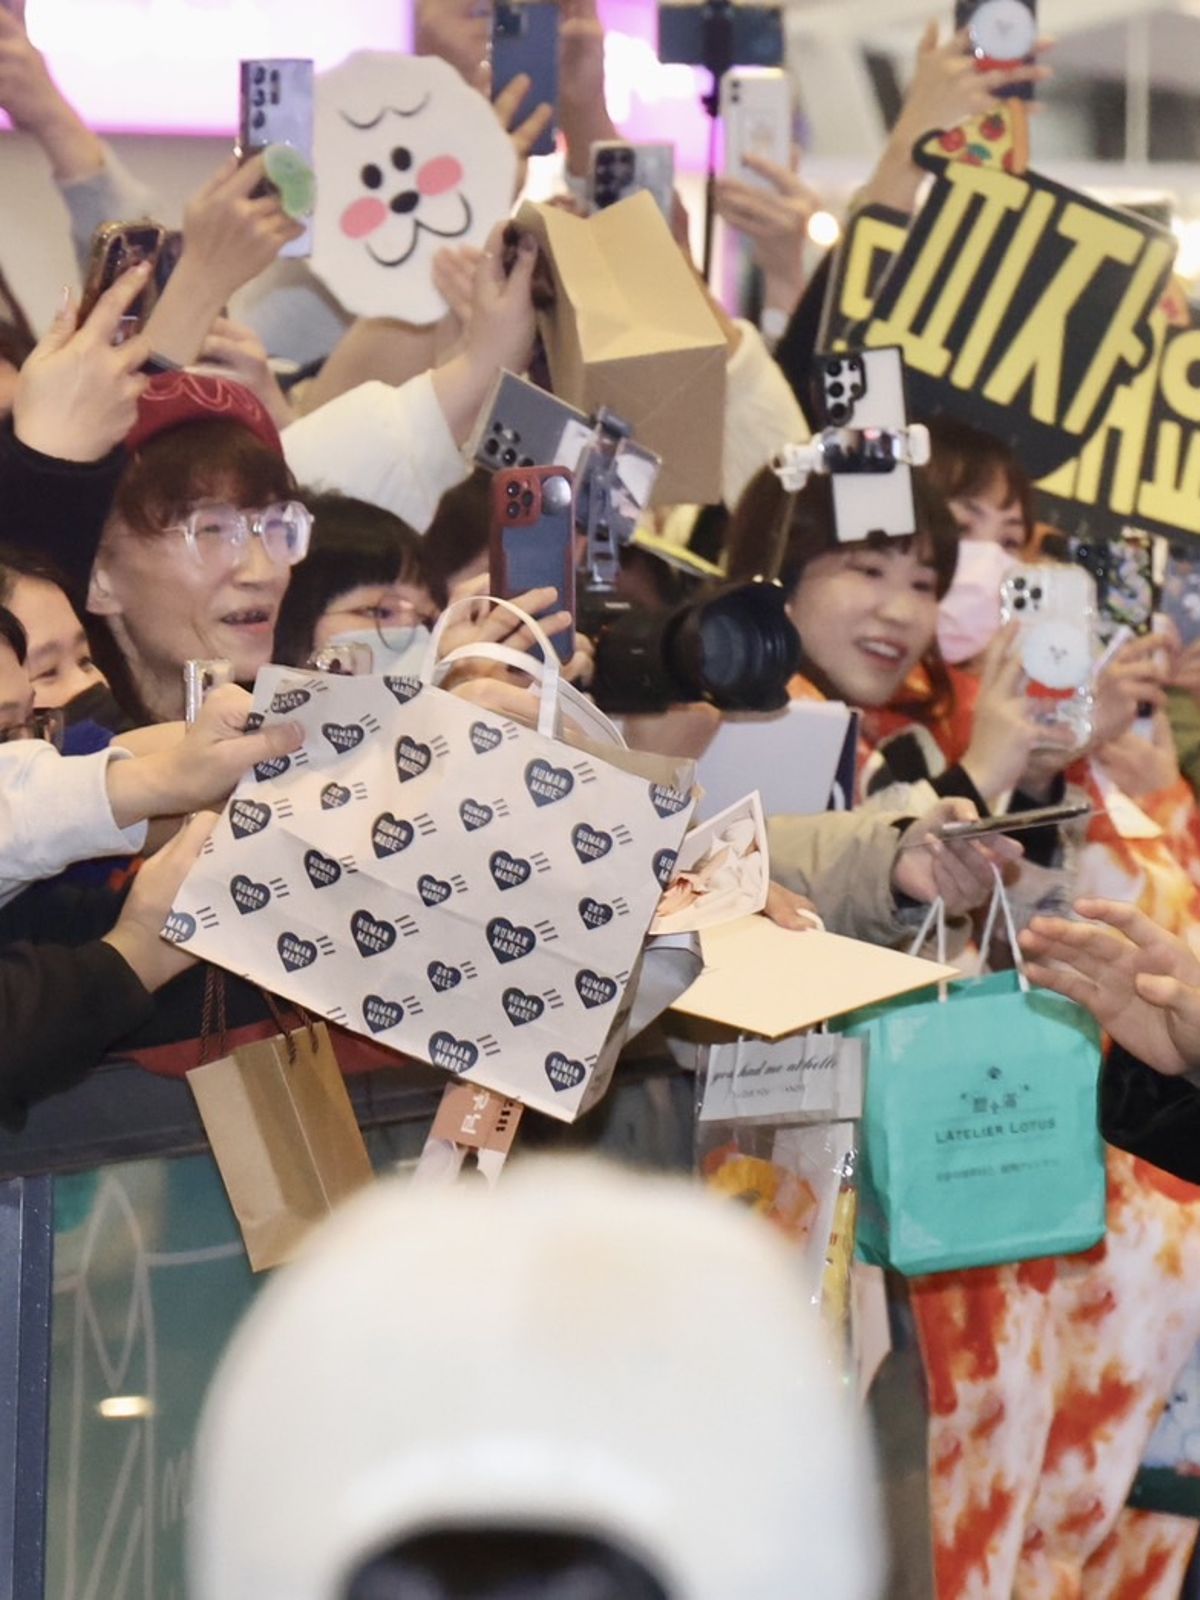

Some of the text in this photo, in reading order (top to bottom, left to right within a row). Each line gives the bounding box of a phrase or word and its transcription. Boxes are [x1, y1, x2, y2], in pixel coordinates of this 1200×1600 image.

[863, 162, 1174, 434] 피자
[327, 727, 358, 739] HUMAN
[330, 735, 353, 748] MADE
[472, 735, 495, 750] MADE
[475, 727, 499, 743] HUMAN
[400, 743, 427, 766] HUMAN
[398, 756, 424, 776] MADE
[531, 766, 567, 790] HUMAN
[530, 779, 560, 801] MADE
[233, 801, 264, 823] HUMAN
[464, 803, 489, 820] HUMAN
[654, 794, 680, 812] MADE
[232, 811, 256, 833] MADE
[463, 812, 485, 827] MADE
[378, 820, 407, 843] HUMAN
[577, 829, 606, 850] HUMAN
[374, 831, 399, 853] MADE
[576, 840, 600, 858] MADE
[309, 856, 336, 877] HUMAN
[309, 866, 331, 884] MADE
[494, 856, 525, 877] HUMAN
[494, 868, 518, 885] MADE
[235, 880, 265, 901] HUMAN
[421, 889, 442, 902] MADE
[422, 879, 447, 896] HUMAN
[235, 891, 258, 909] MADE
[357, 917, 389, 942] HUMAN
[493, 924, 529, 947] HUMAN
[283, 938, 312, 959] HUMAN
[357, 930, 382, 951] MADE
[492, 936, 521, 958] MADE
[282, 949, 306, 967] MADE
[580, 986, 604, 1004] MADE
[581, 975, 611, 995] HUMAN
[367, 1000, 397, 1020] HUMAN
[508, 993, 538, 1012] HUMAN
[508, 1004, 531, 1021] MADE
[367, 1011, 391, 1028] MADE
[435, 1039, 470, 1061] HUMAN
[434, 1051, 462, 1073] MADE
[549, 1057, 580, 1078] HUMAN
[737, 1060, 766, 1079] had
[763, 1064, 782, 1077] me
[549, 1068, 573, 1087] MADE
[1009, 1117, 1056, 1135] LOTUS
